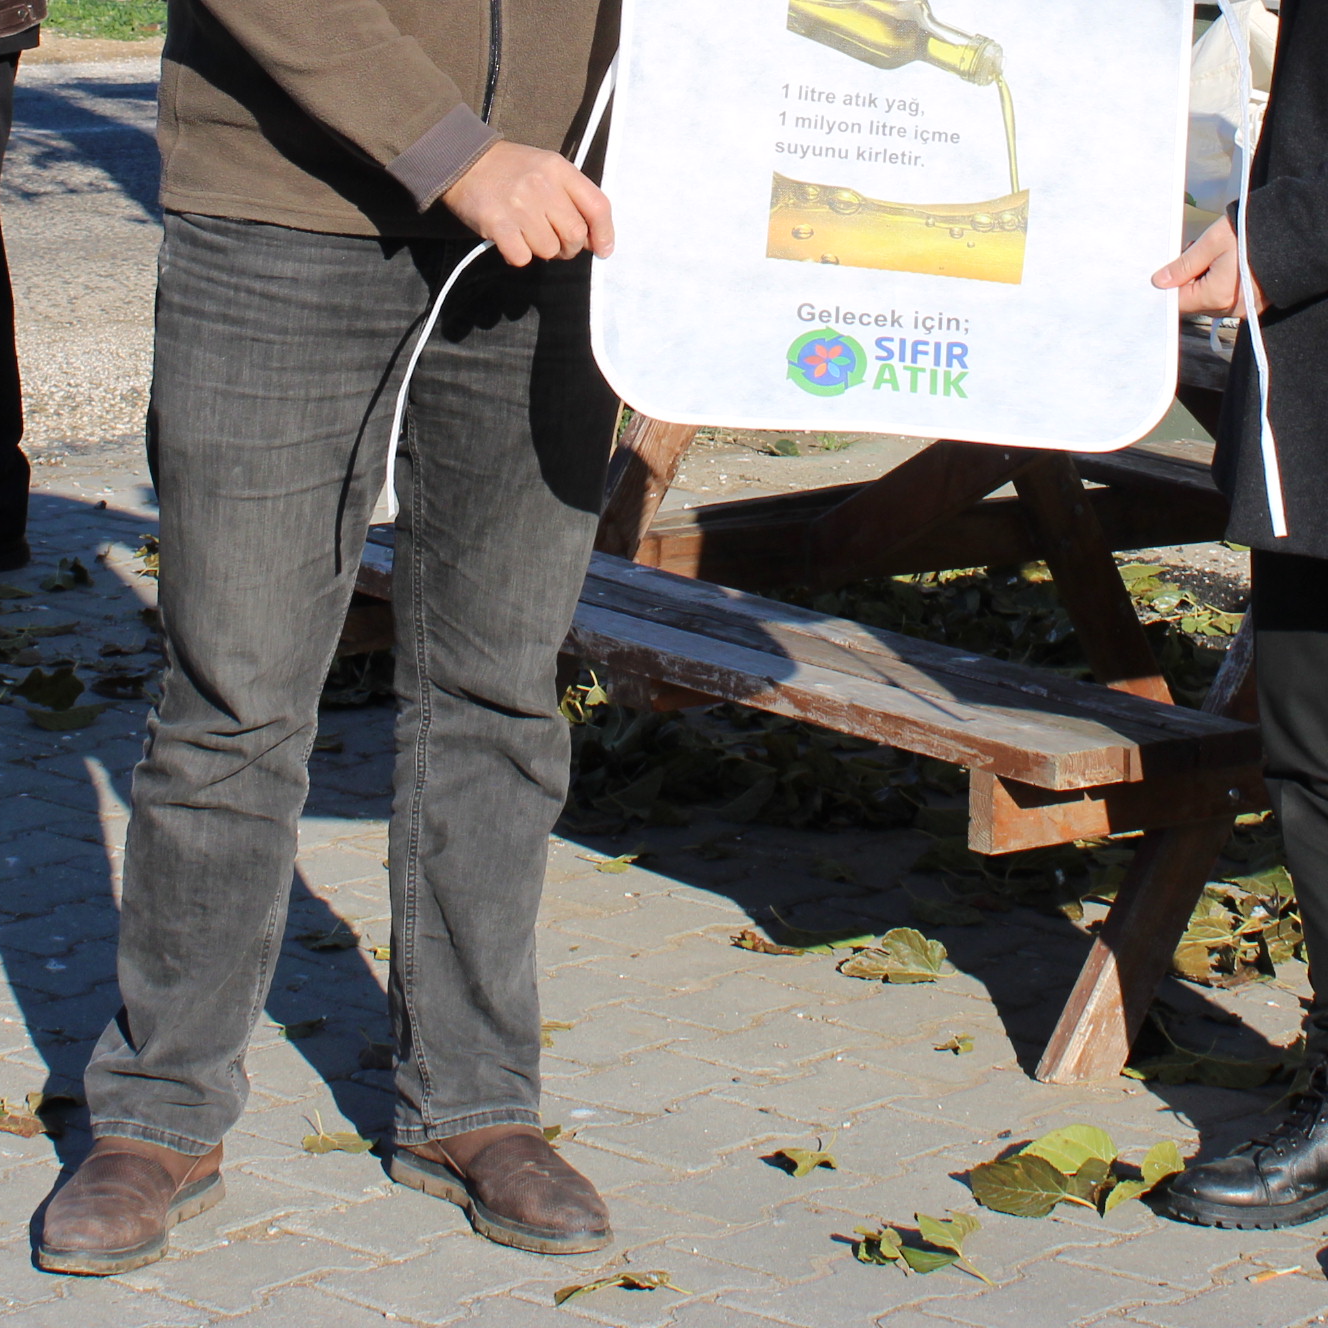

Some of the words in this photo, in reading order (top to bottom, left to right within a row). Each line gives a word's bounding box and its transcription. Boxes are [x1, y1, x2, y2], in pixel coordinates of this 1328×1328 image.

[781, 83, 790, 99] 1
[798, 85, 836, 104] litre
[842, 92, 879, 109] atık
[885, 97, 925, 117] yağ,
[778, 111, 787, 127] 1
[794, 114, 862, 135] milyon
[869, 120, 907, 138] litre
[914, 125, 961, 145] içme
[775, 141, 849, 160] suyunu
[856, 146, 925, 168] kirletir.
[797, 302, 904, 329] Gelecek
[913, 310, 970, 335] için;
[874, 336, 969, 370] SIFIR
[872, 363, 969, 400] ATIK
